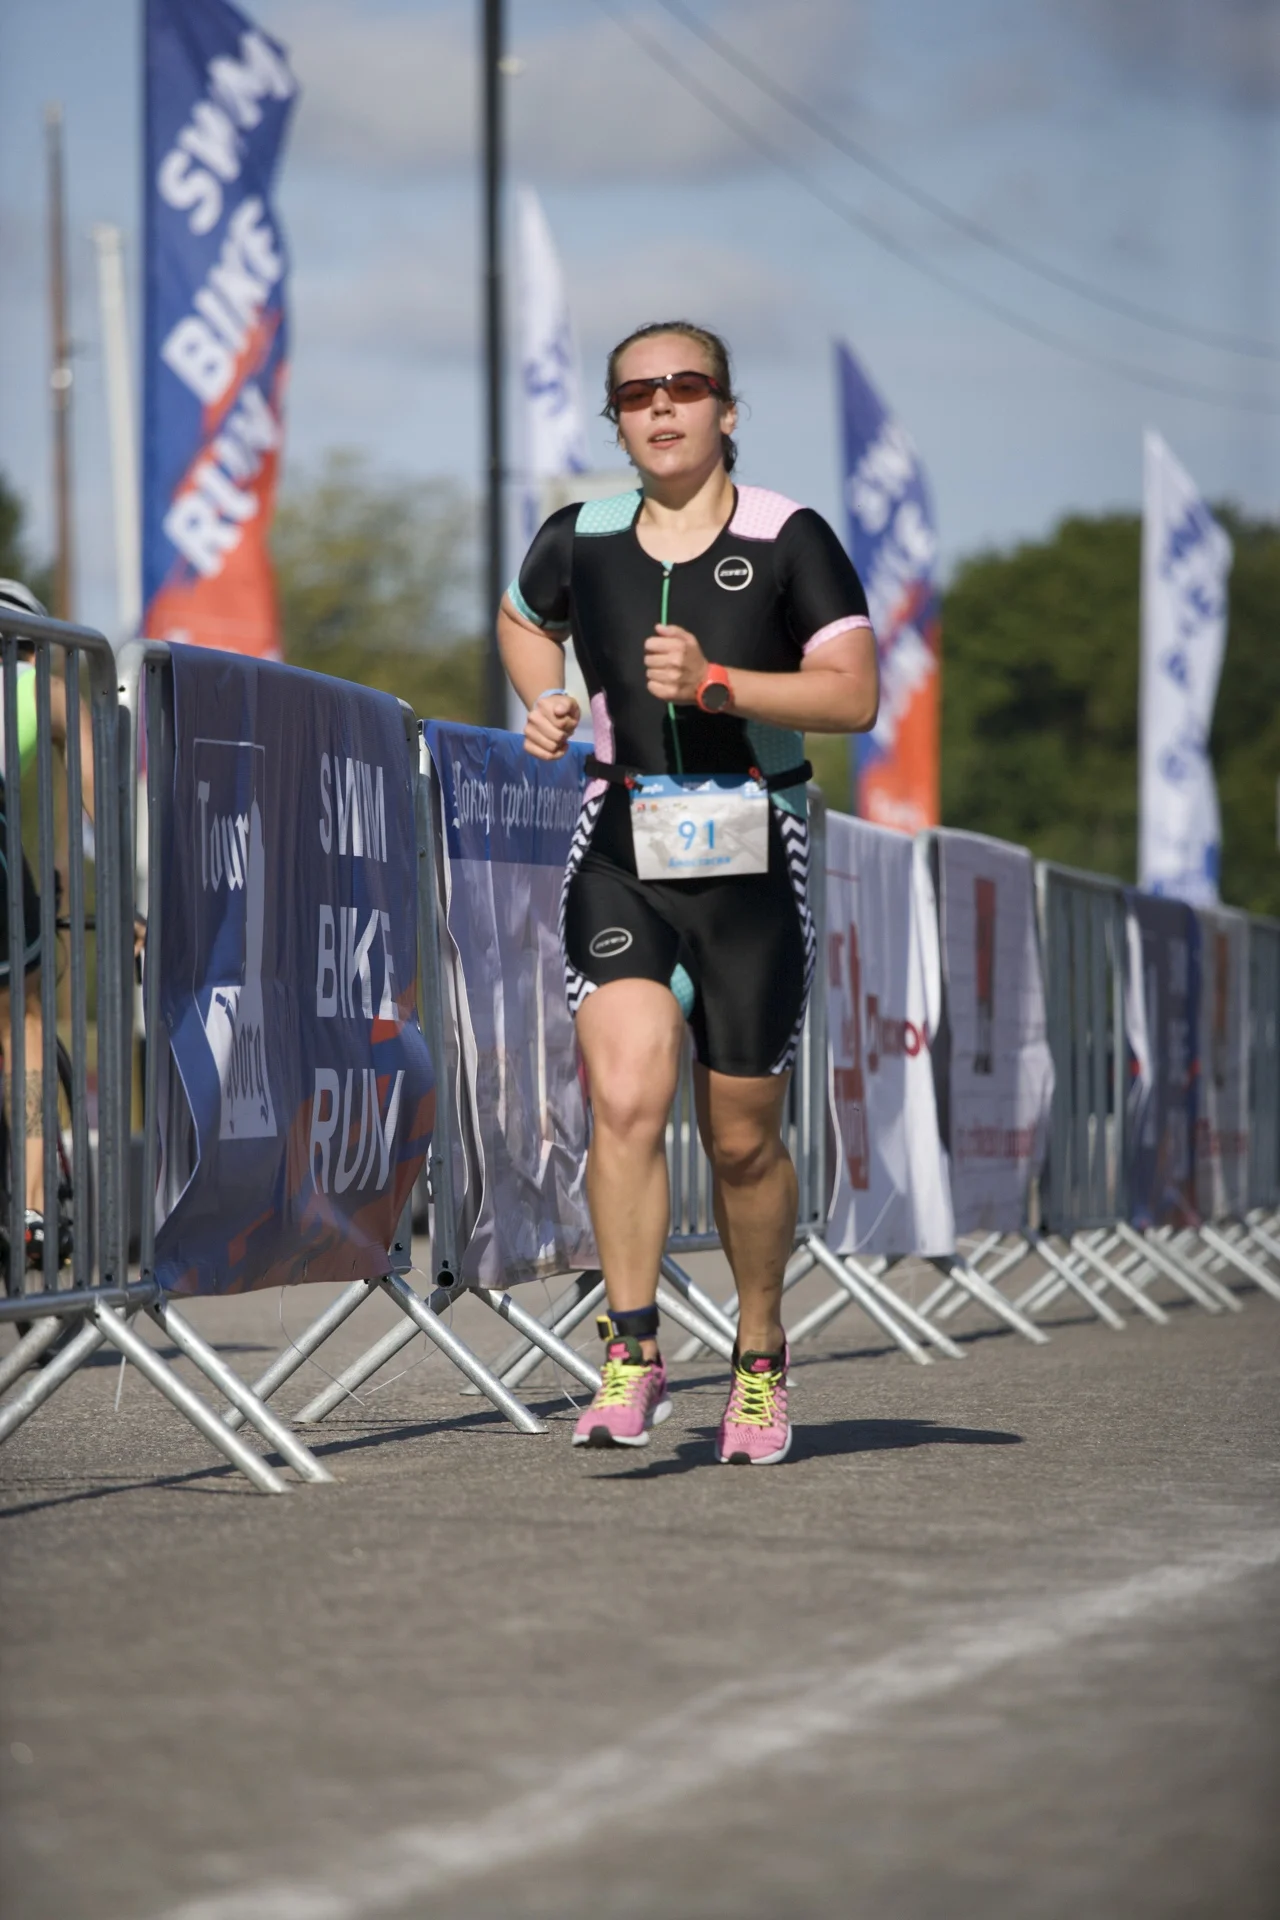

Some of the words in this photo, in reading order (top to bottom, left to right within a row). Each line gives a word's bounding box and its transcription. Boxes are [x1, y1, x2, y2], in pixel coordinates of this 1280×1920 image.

[160, 198, 283, 408] BIKE
[197, 780, 250, 893] Tour
[319, 752, 387, 863] SWIM
[677, 819, 716, 851] 91
[317, 905, 399, 1021] BIKE
[309, 1067, 405, 1195] RUN
